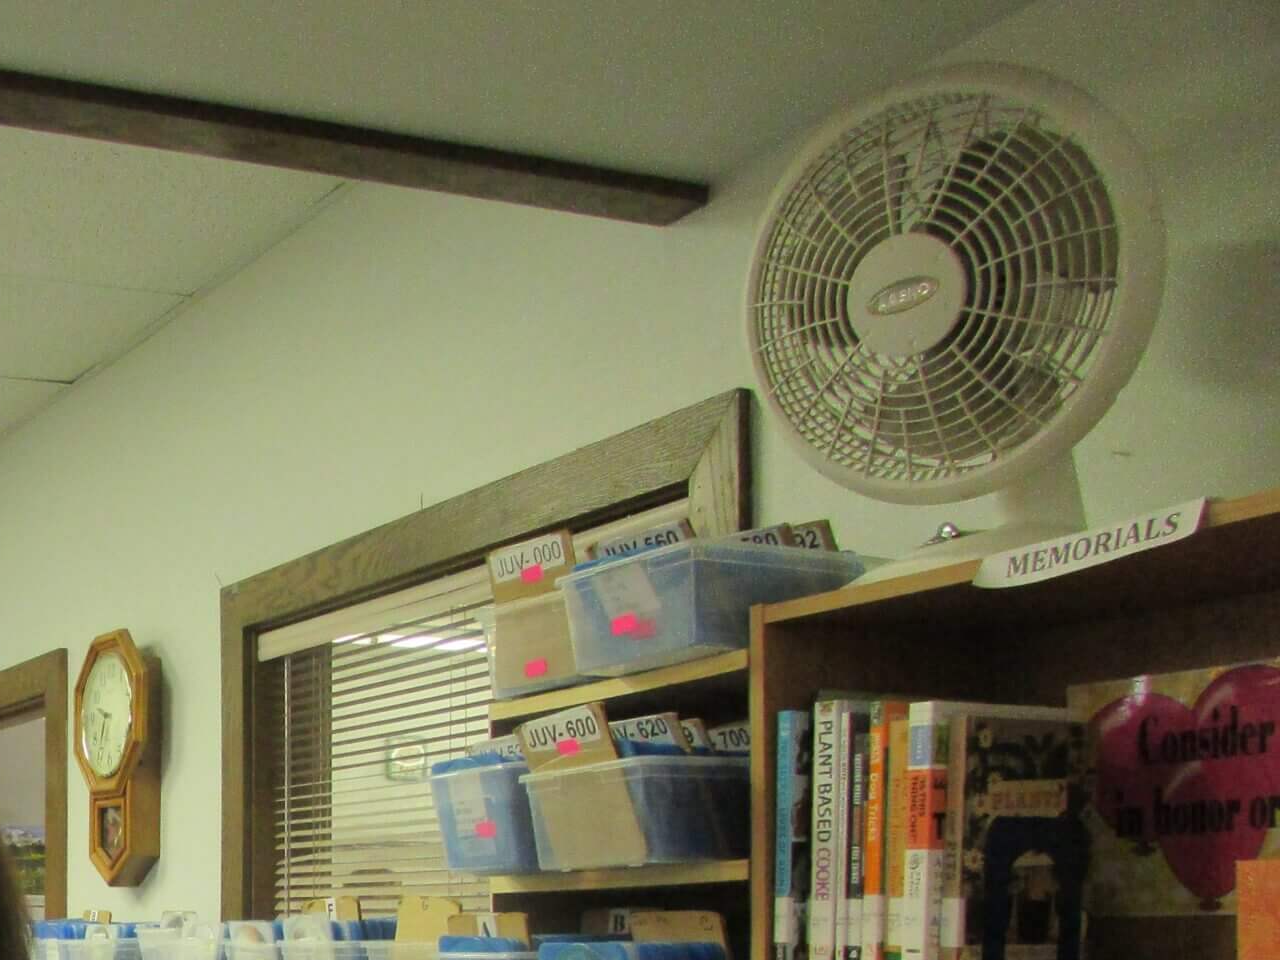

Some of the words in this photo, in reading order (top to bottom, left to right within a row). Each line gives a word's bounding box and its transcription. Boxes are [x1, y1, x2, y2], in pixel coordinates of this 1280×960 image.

[496, 540, 563, 579] JUV-000
[1005, 511, 1183, 579] MEMORIALS
[528, 715, 597, 749] JUV-600
[817, 720, 834, 779] PLANT
[1136, 704, 1276, 767] Consider
[816, 782, 834, 844] BASED
[1153, 786, 1241, 836] honor
